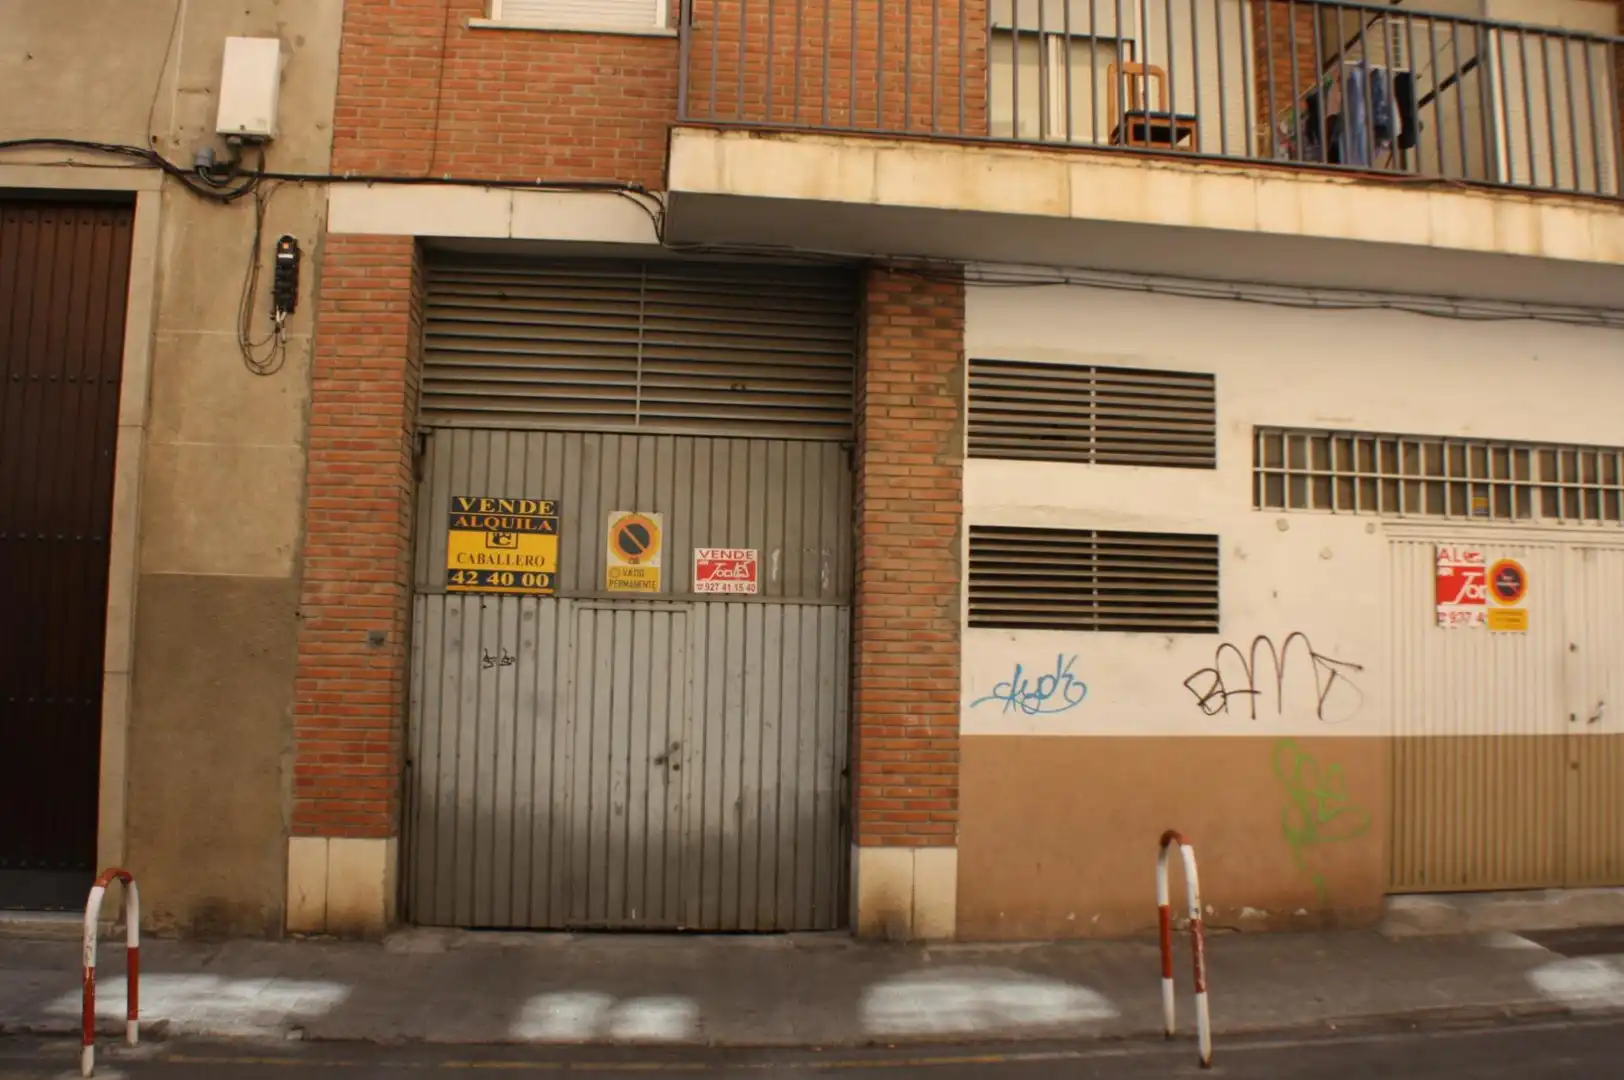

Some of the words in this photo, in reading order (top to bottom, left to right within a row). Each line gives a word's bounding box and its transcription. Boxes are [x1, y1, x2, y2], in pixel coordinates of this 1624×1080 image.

[458, 497, 554, 515] VENDE
[455, 515, 552, 530] ALQUILA
[456, 552, 545, 567] CABALLERO
[699, 550, 753, 559] VENDE
[451, 570, 479, 584] 42
[487, 571, 514, 586] 40
[521, 572, 549, 587] 00
[705, 583, 719, 592] 927
